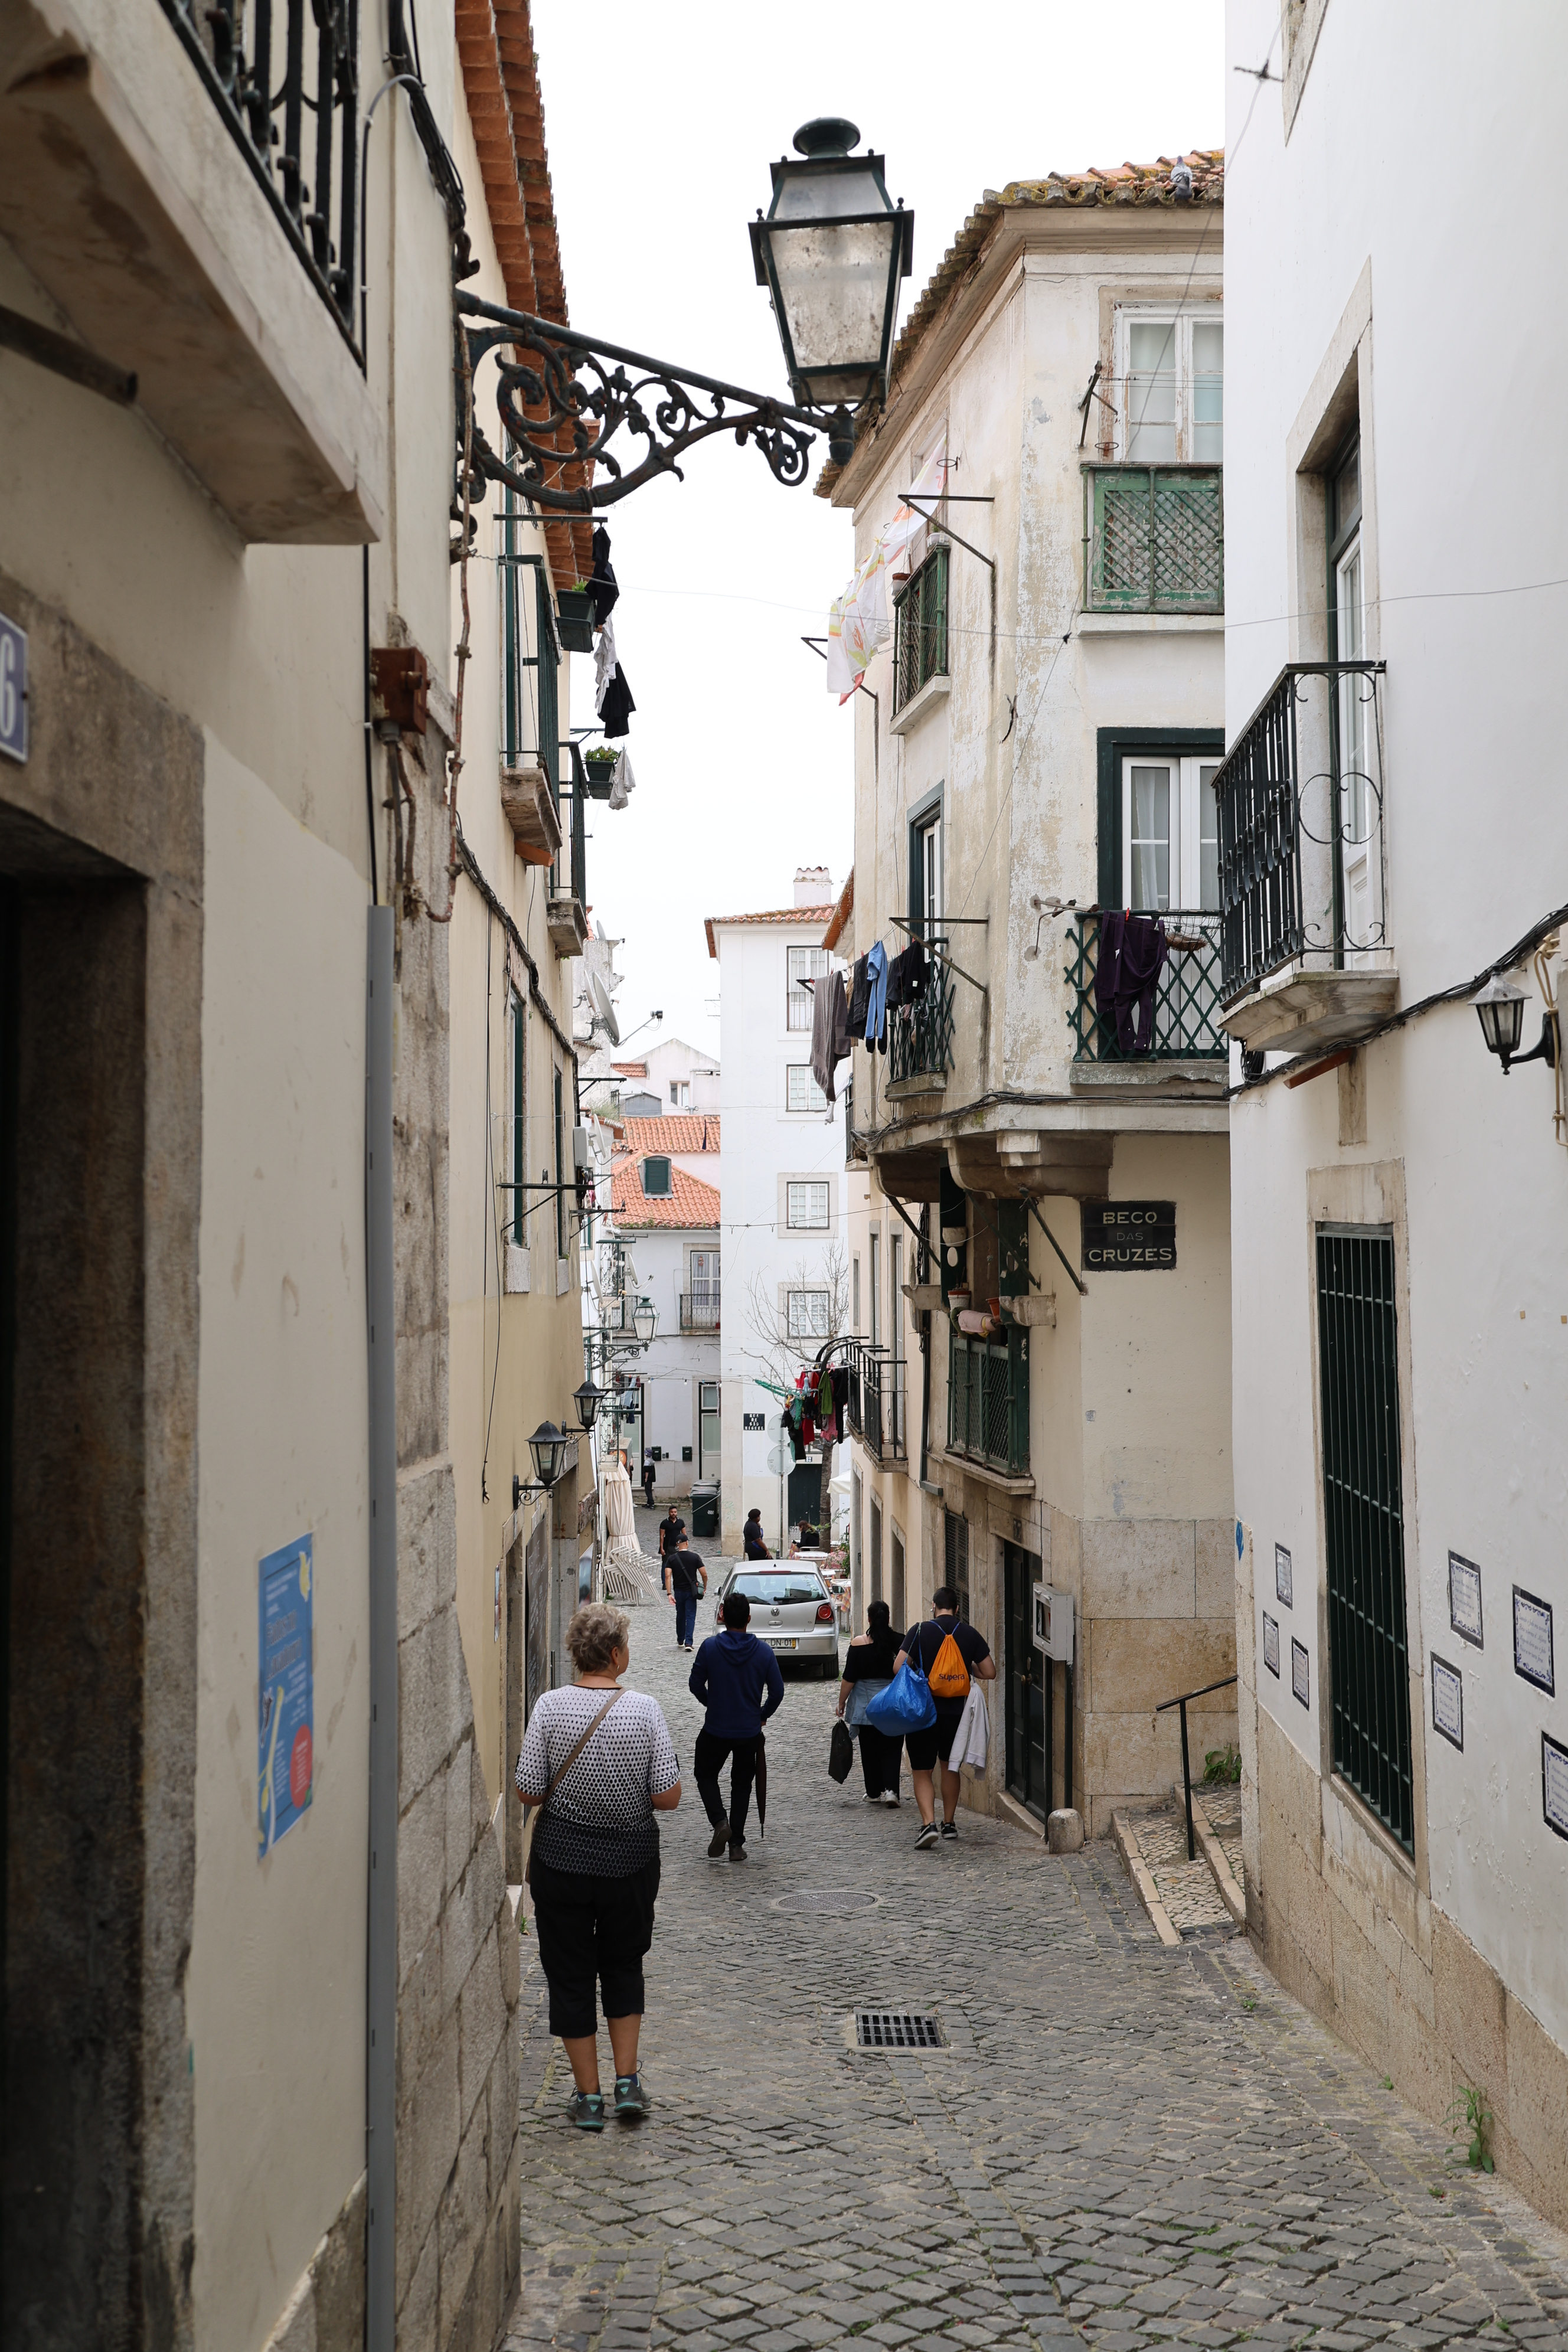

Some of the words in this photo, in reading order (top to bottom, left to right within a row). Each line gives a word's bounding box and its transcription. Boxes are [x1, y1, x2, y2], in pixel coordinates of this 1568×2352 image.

[1103, 1211, 1158, 1224] BECO
[1116, 1232, 1144, 1241] DAS
[1089, 1248, 1172, 1262] CRUZES
[939, 1673, 965, 1681] supera
